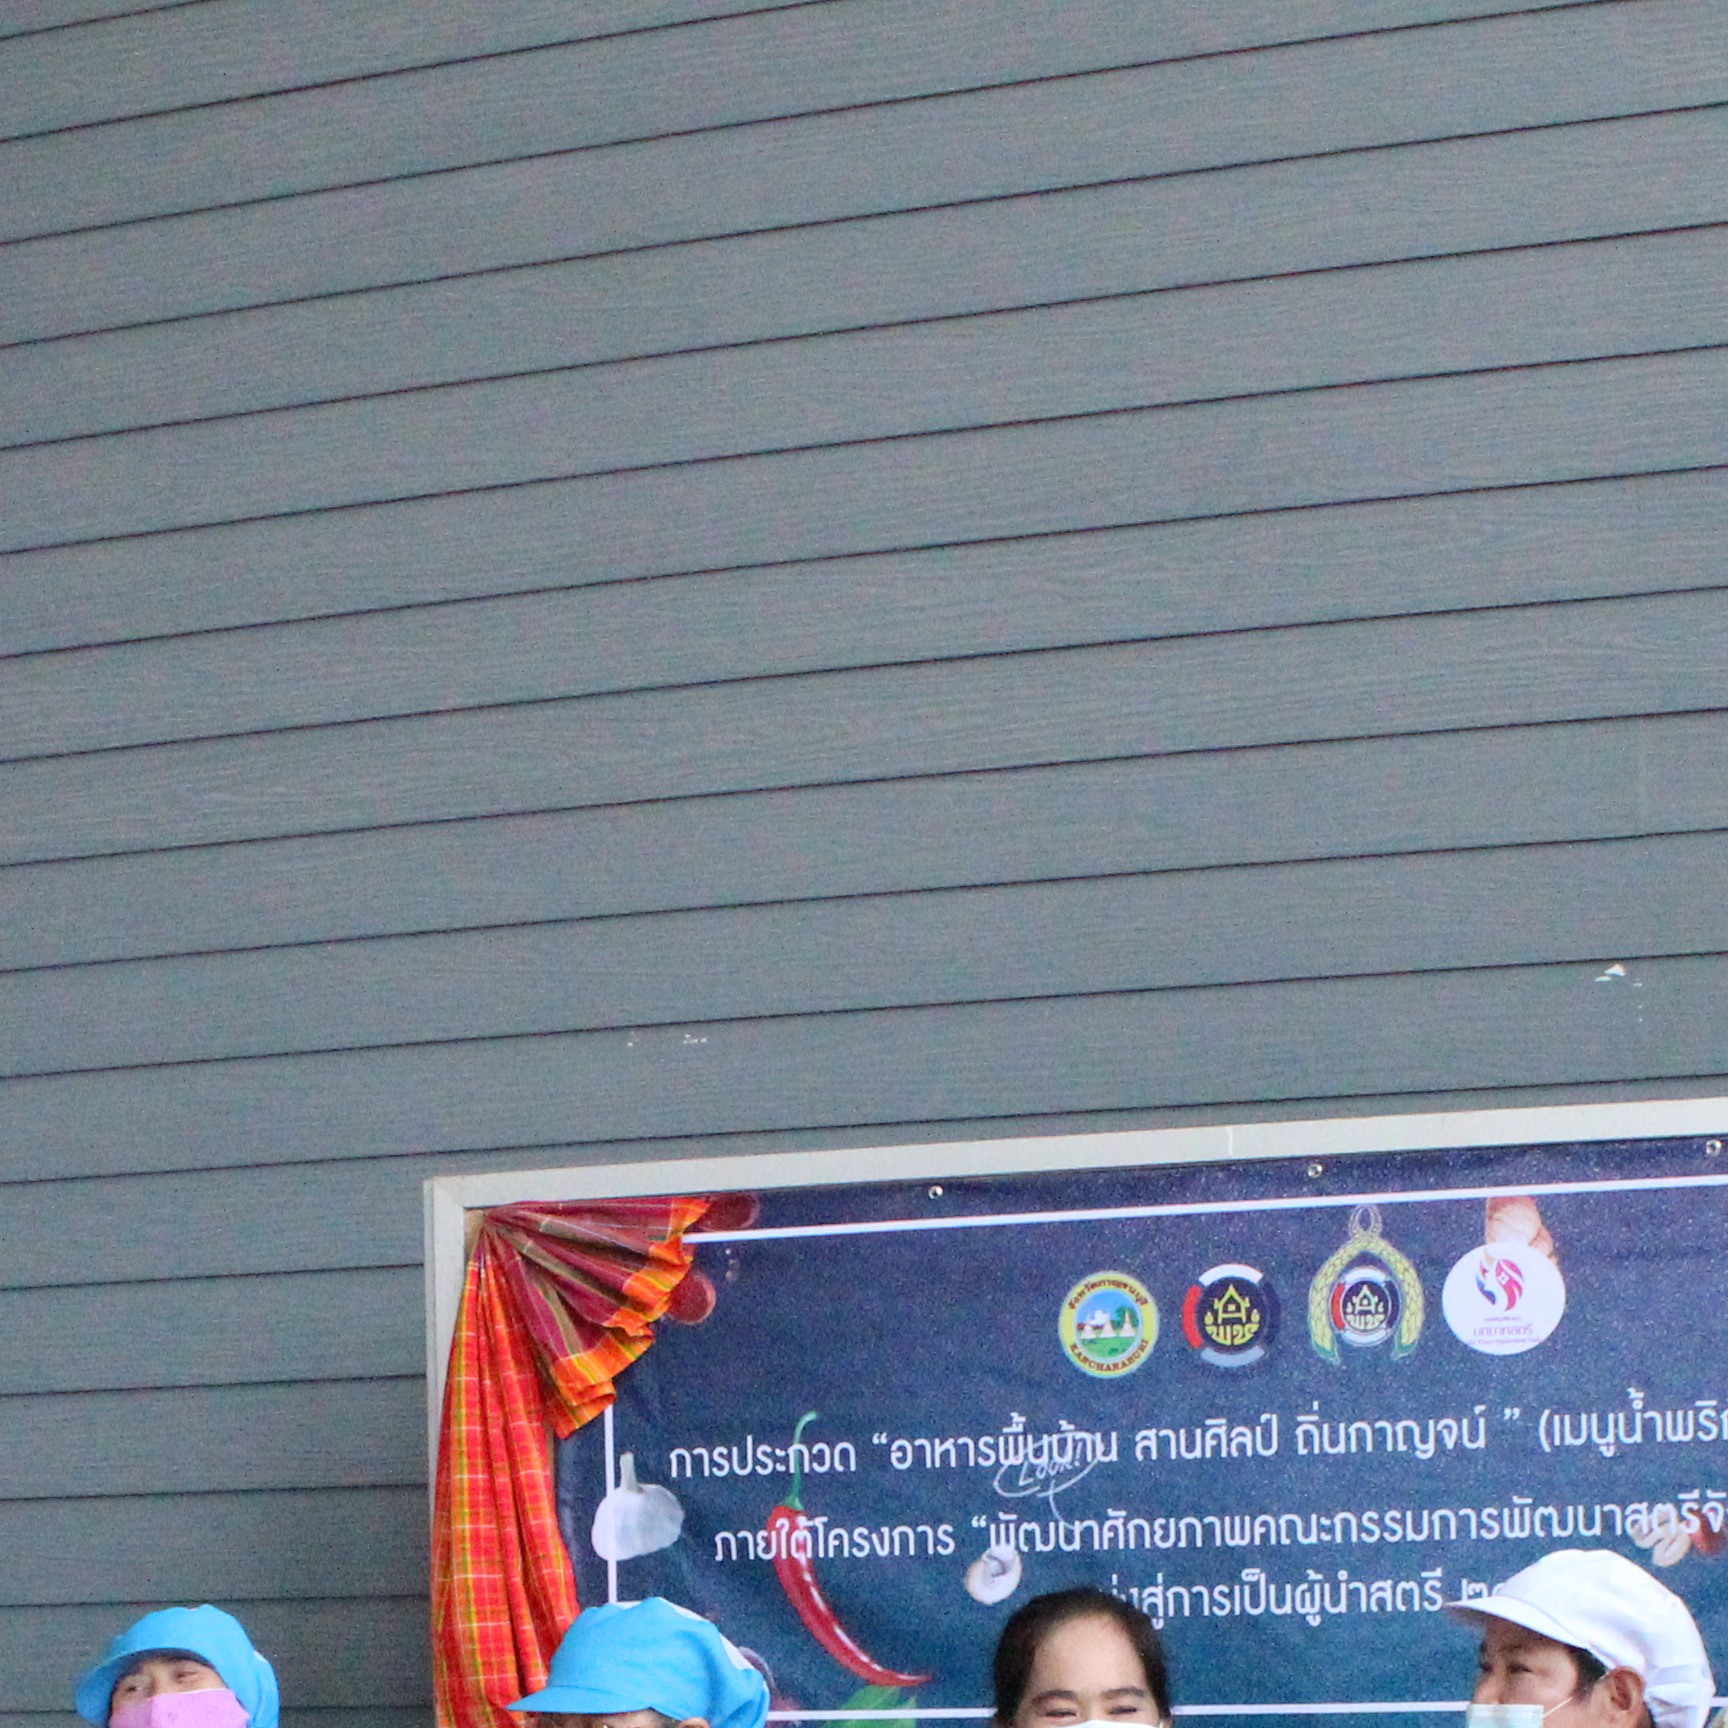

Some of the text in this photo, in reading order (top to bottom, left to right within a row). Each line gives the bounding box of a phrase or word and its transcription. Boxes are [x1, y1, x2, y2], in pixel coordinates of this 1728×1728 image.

[670, 1435, 856, 1478] การประกวด
[1134, 1413, 1279, 1461] สานศิลป์
[1294, 1400, 1488, 1460] ถิ่นกาญจน์
[714, 1515, 956, 1562] ภายใต้โครงการ
